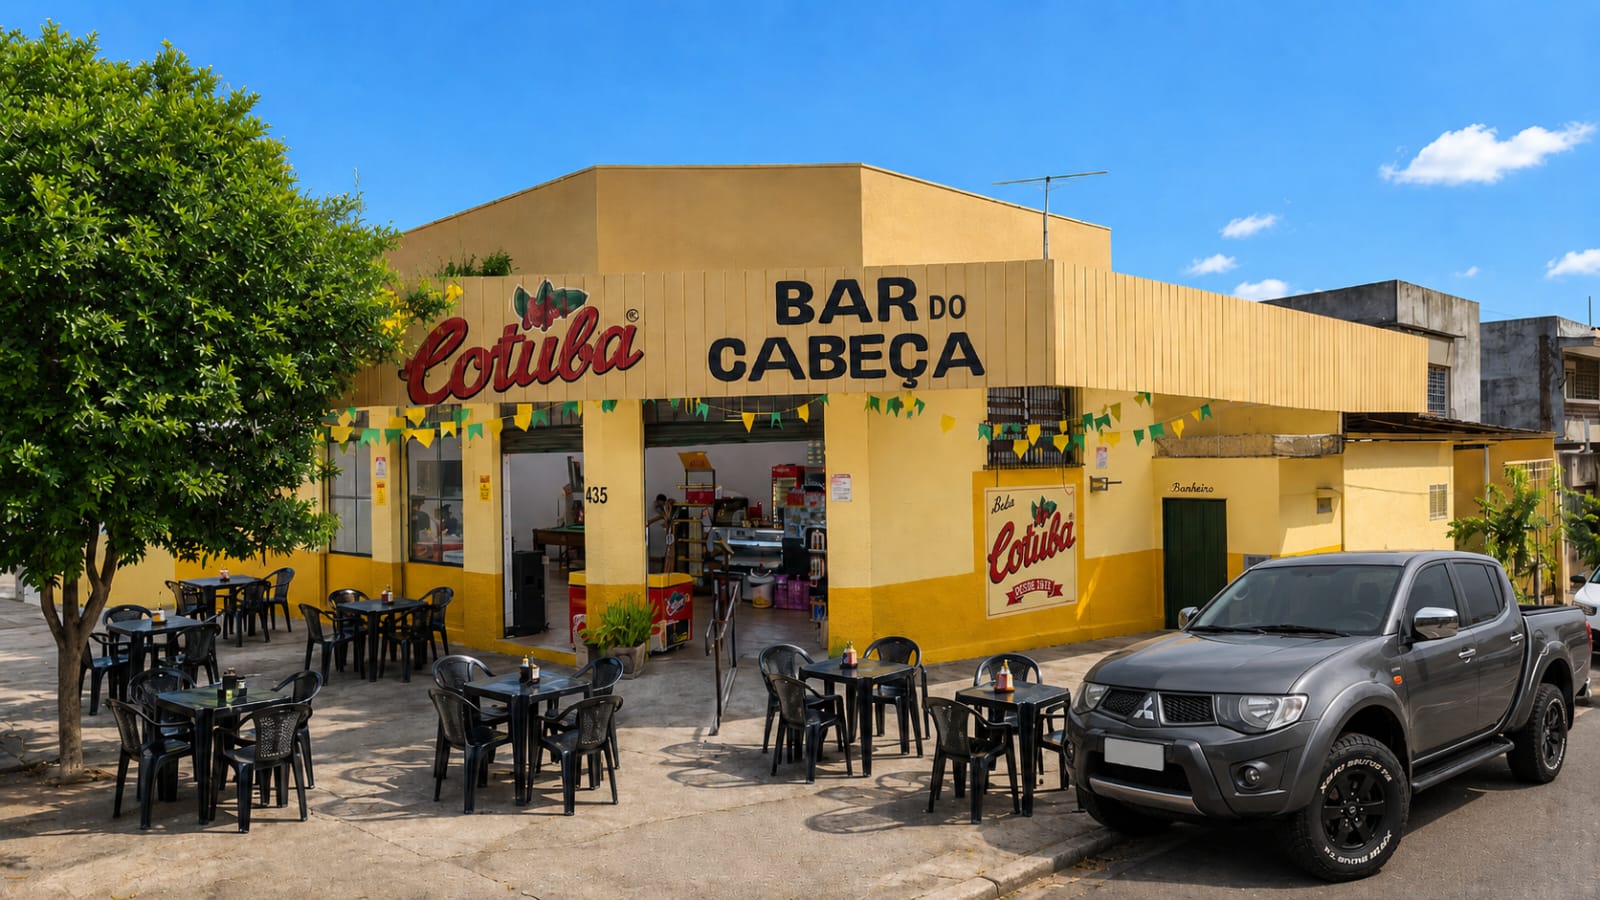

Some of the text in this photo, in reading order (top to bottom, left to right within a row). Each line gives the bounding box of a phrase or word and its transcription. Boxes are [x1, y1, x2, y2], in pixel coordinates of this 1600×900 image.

[775, 277, 966, 325] BAR DO
[398, 305, 644, 405] Cotuba
[708, 331, 985, 388] CABEÇA
[585, 486, 608, 504] 435
[1170, 481, 1214, 493] Banheiro
[988, 511, 1076, 584] Cotuba
